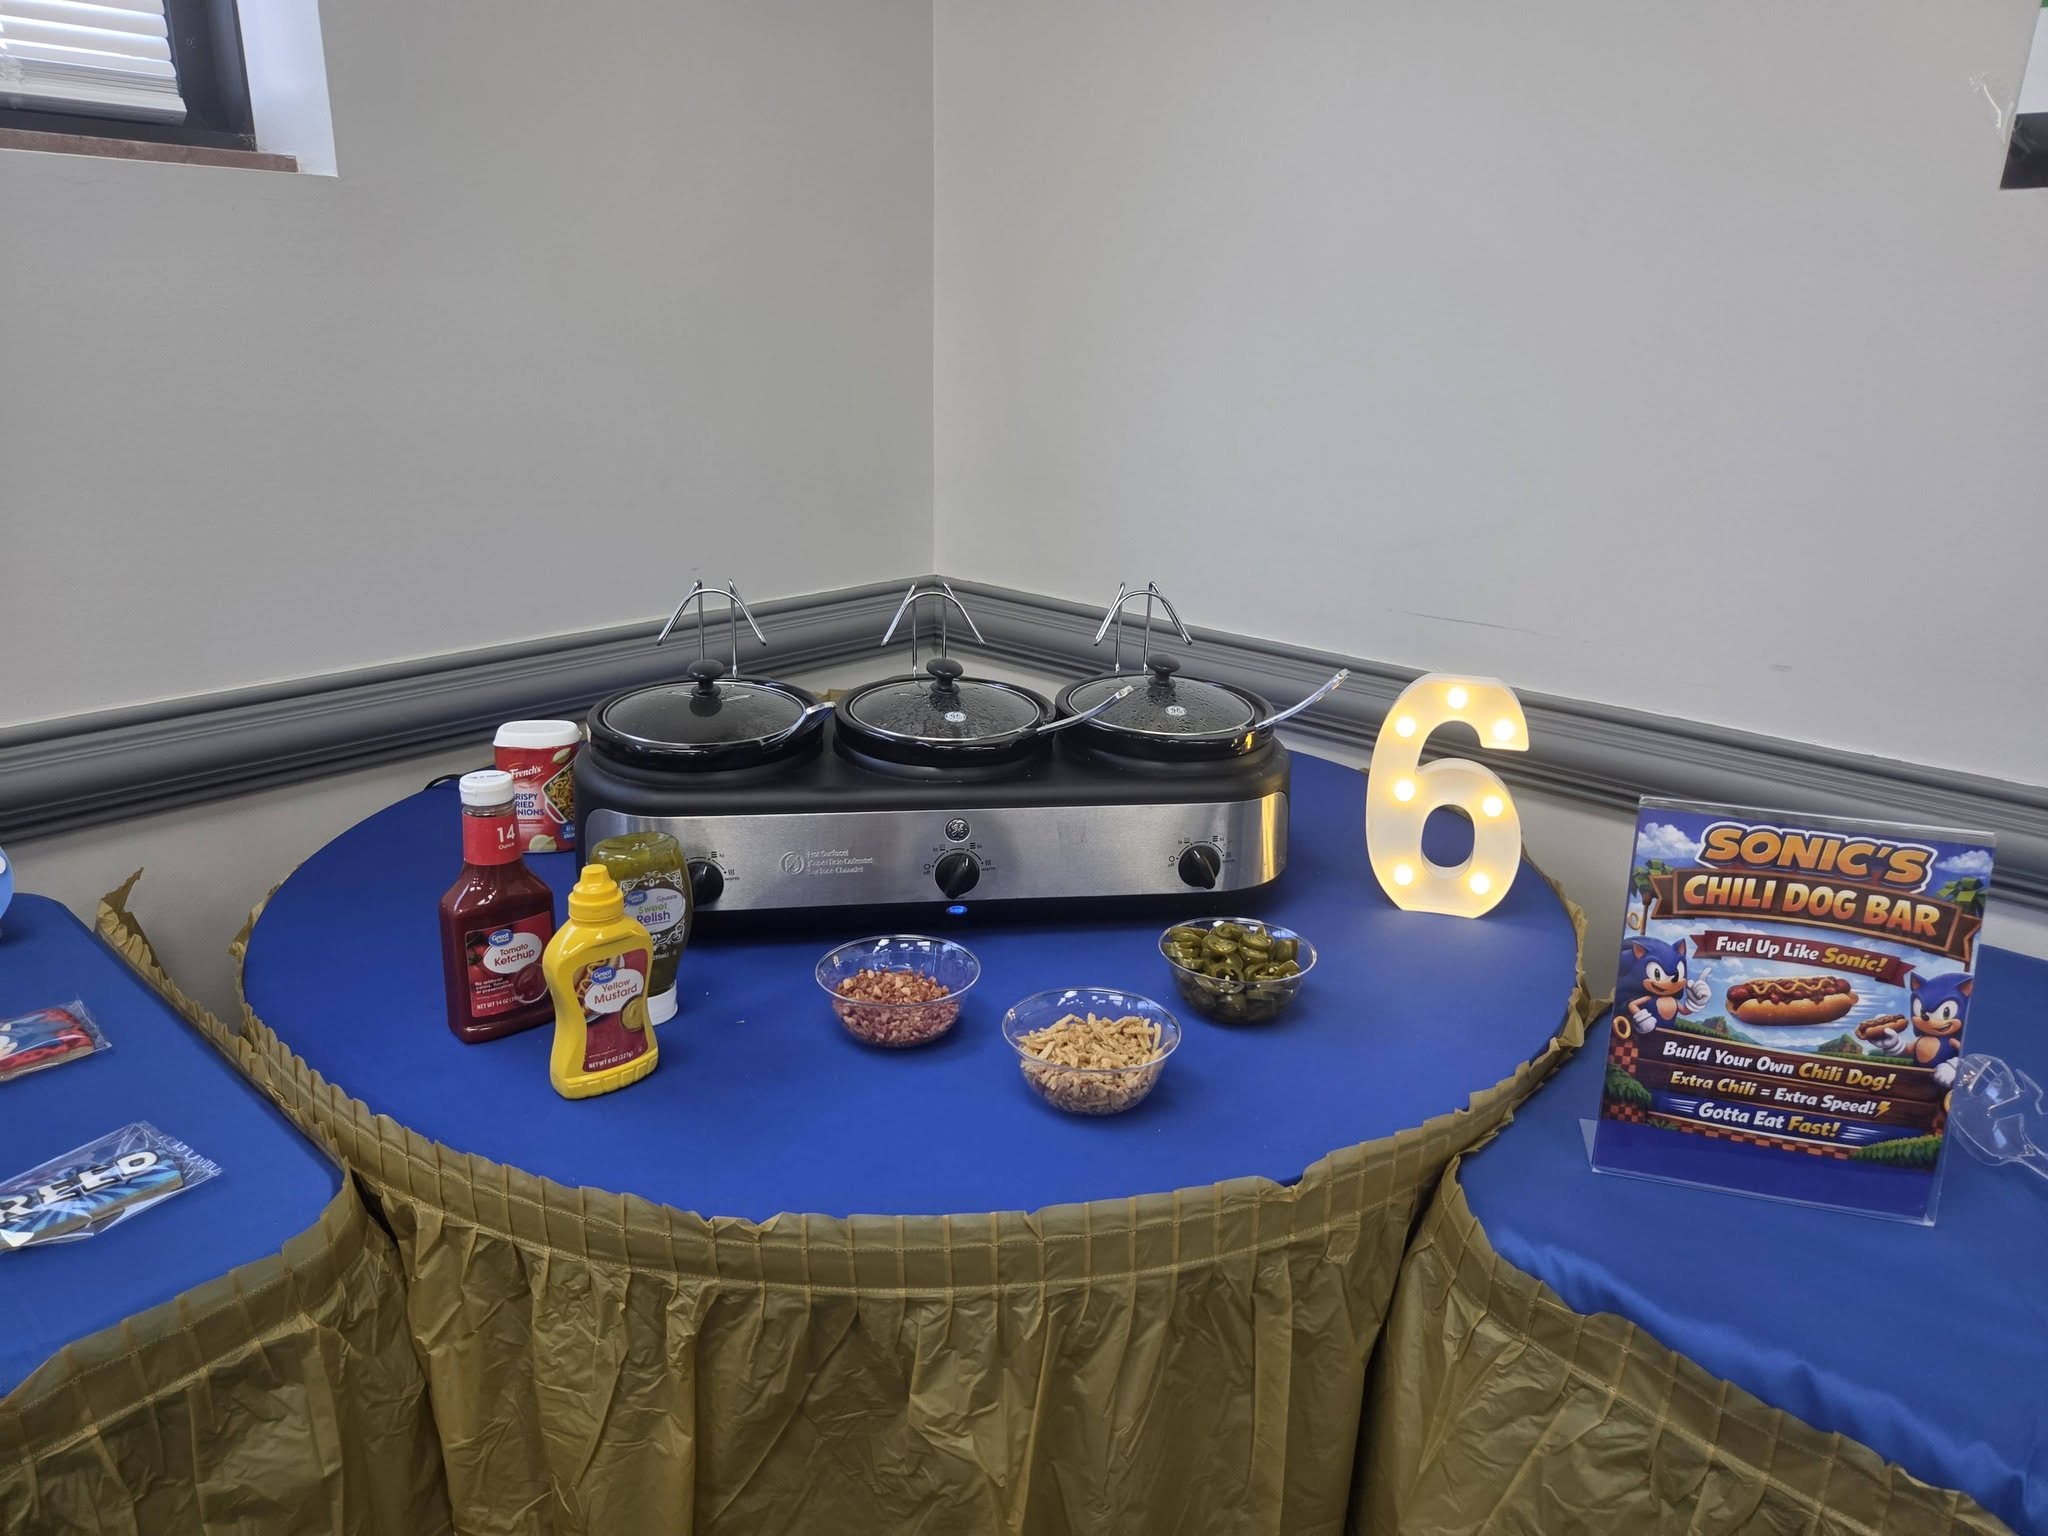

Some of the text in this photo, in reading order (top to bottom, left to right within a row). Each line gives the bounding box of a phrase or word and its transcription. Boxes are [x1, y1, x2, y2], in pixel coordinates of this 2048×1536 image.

[510, 766, 542, 779] French's
[514, 793, 538, 801] RISPY
[1366, 672, 1529, 919] 6
[497, 824, 515, 843] 14
[498, 842, 515, 850] Ounce
[1704, 827, 1930, 884] SONIC'S
[638, 903, 667, 914] Sweet
[1683, 875, 1941, 937] CHILI DOG BAR
[637, 911, 671, 925] Relish
[494, 949, 536, 967] Ketchup
[499, 943, 529, 956] Tomato
[1716, 935, 1888, 973] Fuel Up Like Sonic!
[594, 984, 638, 1005] Mustard
[601, 978, 631, 993] Yellow
[588, 1061, 598, 1069] NET
[1663, 1041, 1896, 1091] Build Your Own Chili Dog!
[1670, 1070, 1714, 1090] Extra
[1717, 1078, 1757, 1096] Chili
[1774, 1087, 1818, 1107] Extra
[1820, 1094, 1878, 1115] Speed!
[1698, 1102, 1841, 1138] Gotta Eat Fast!
